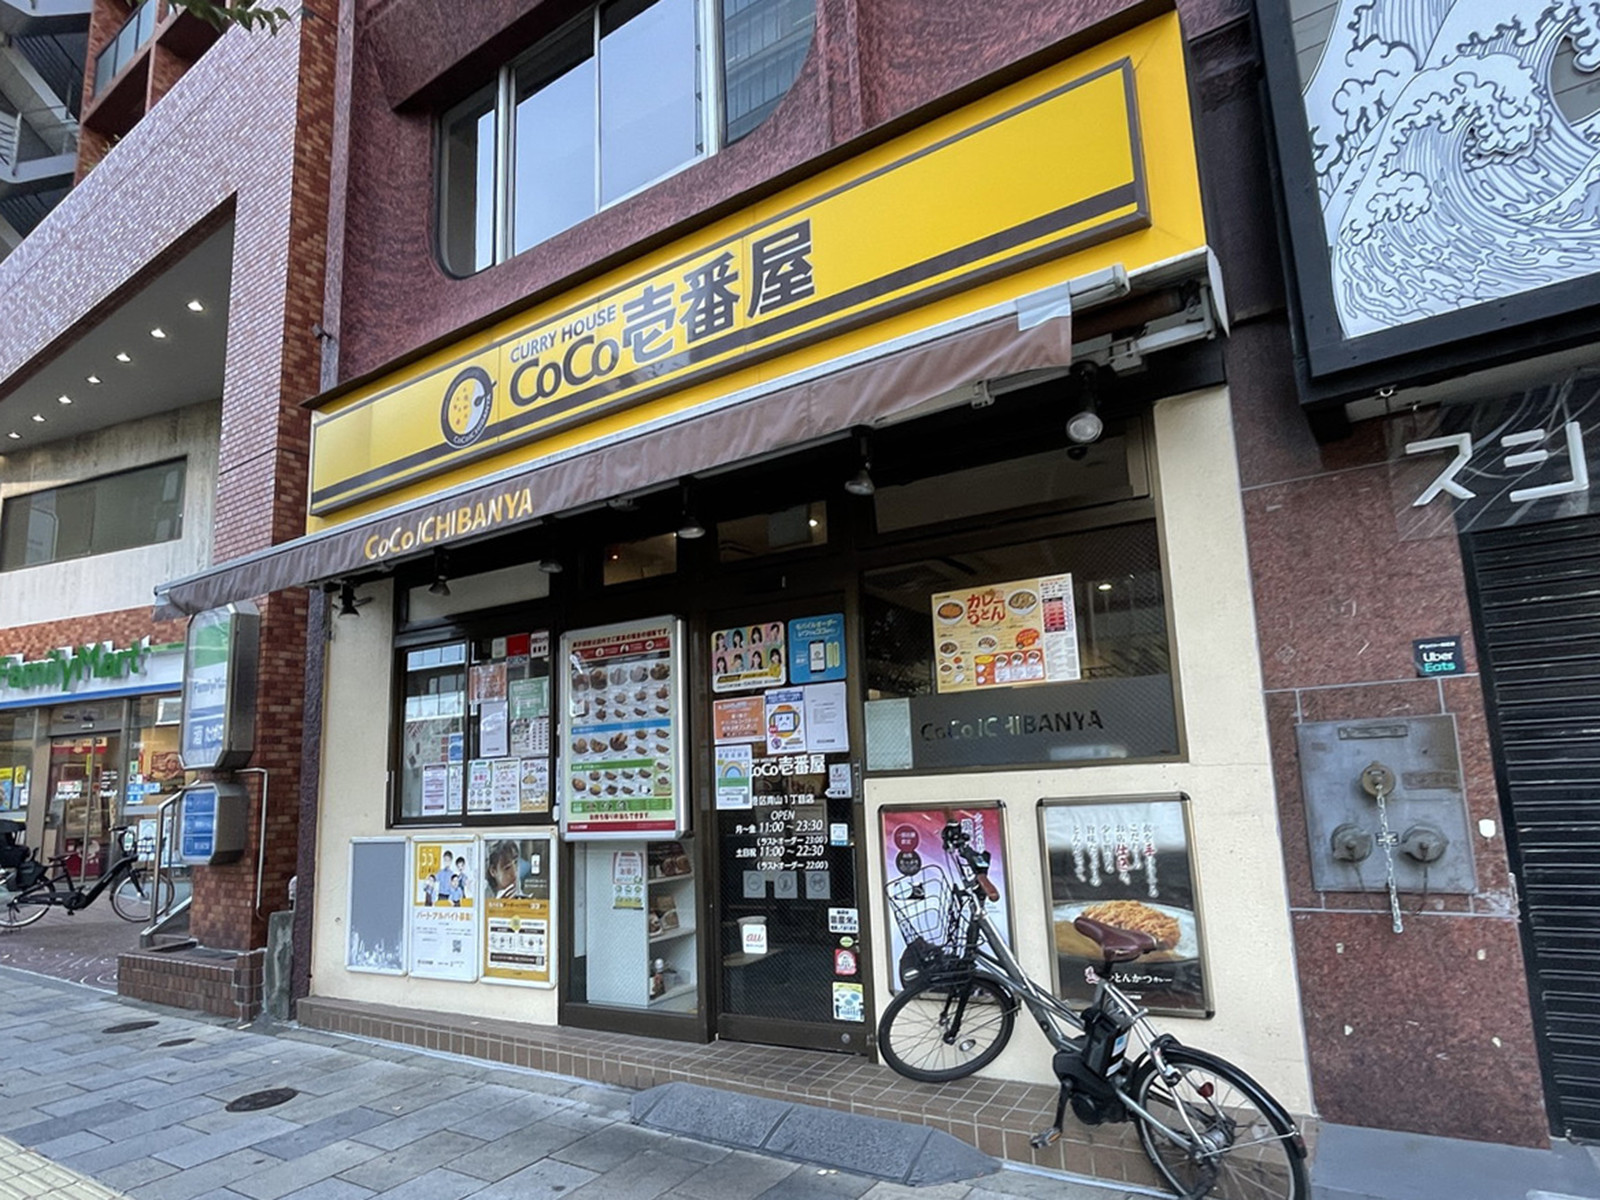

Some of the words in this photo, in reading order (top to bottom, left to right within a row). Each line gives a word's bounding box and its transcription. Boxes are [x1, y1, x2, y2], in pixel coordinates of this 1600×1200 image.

[509, 219, 816, 407] CoCo壱番屋
[510, 330, 557, 363] CURRY
[561, 304, 617, 348] HOUSE
[967, 608, 1005, 625] うどん
[1423, 652, 1454, 662] Uber
[1424, 662, 1456, 672] Eats
[770, 810, 796, 821] OPEN
[760, 821, 785, 833] 11:00
[795, 819, 823, 832] 23:30
[760, 845, 785, 857] 11:00
[795, 844, 824, 857] 22:30
[746, 933, 764, 943] au
